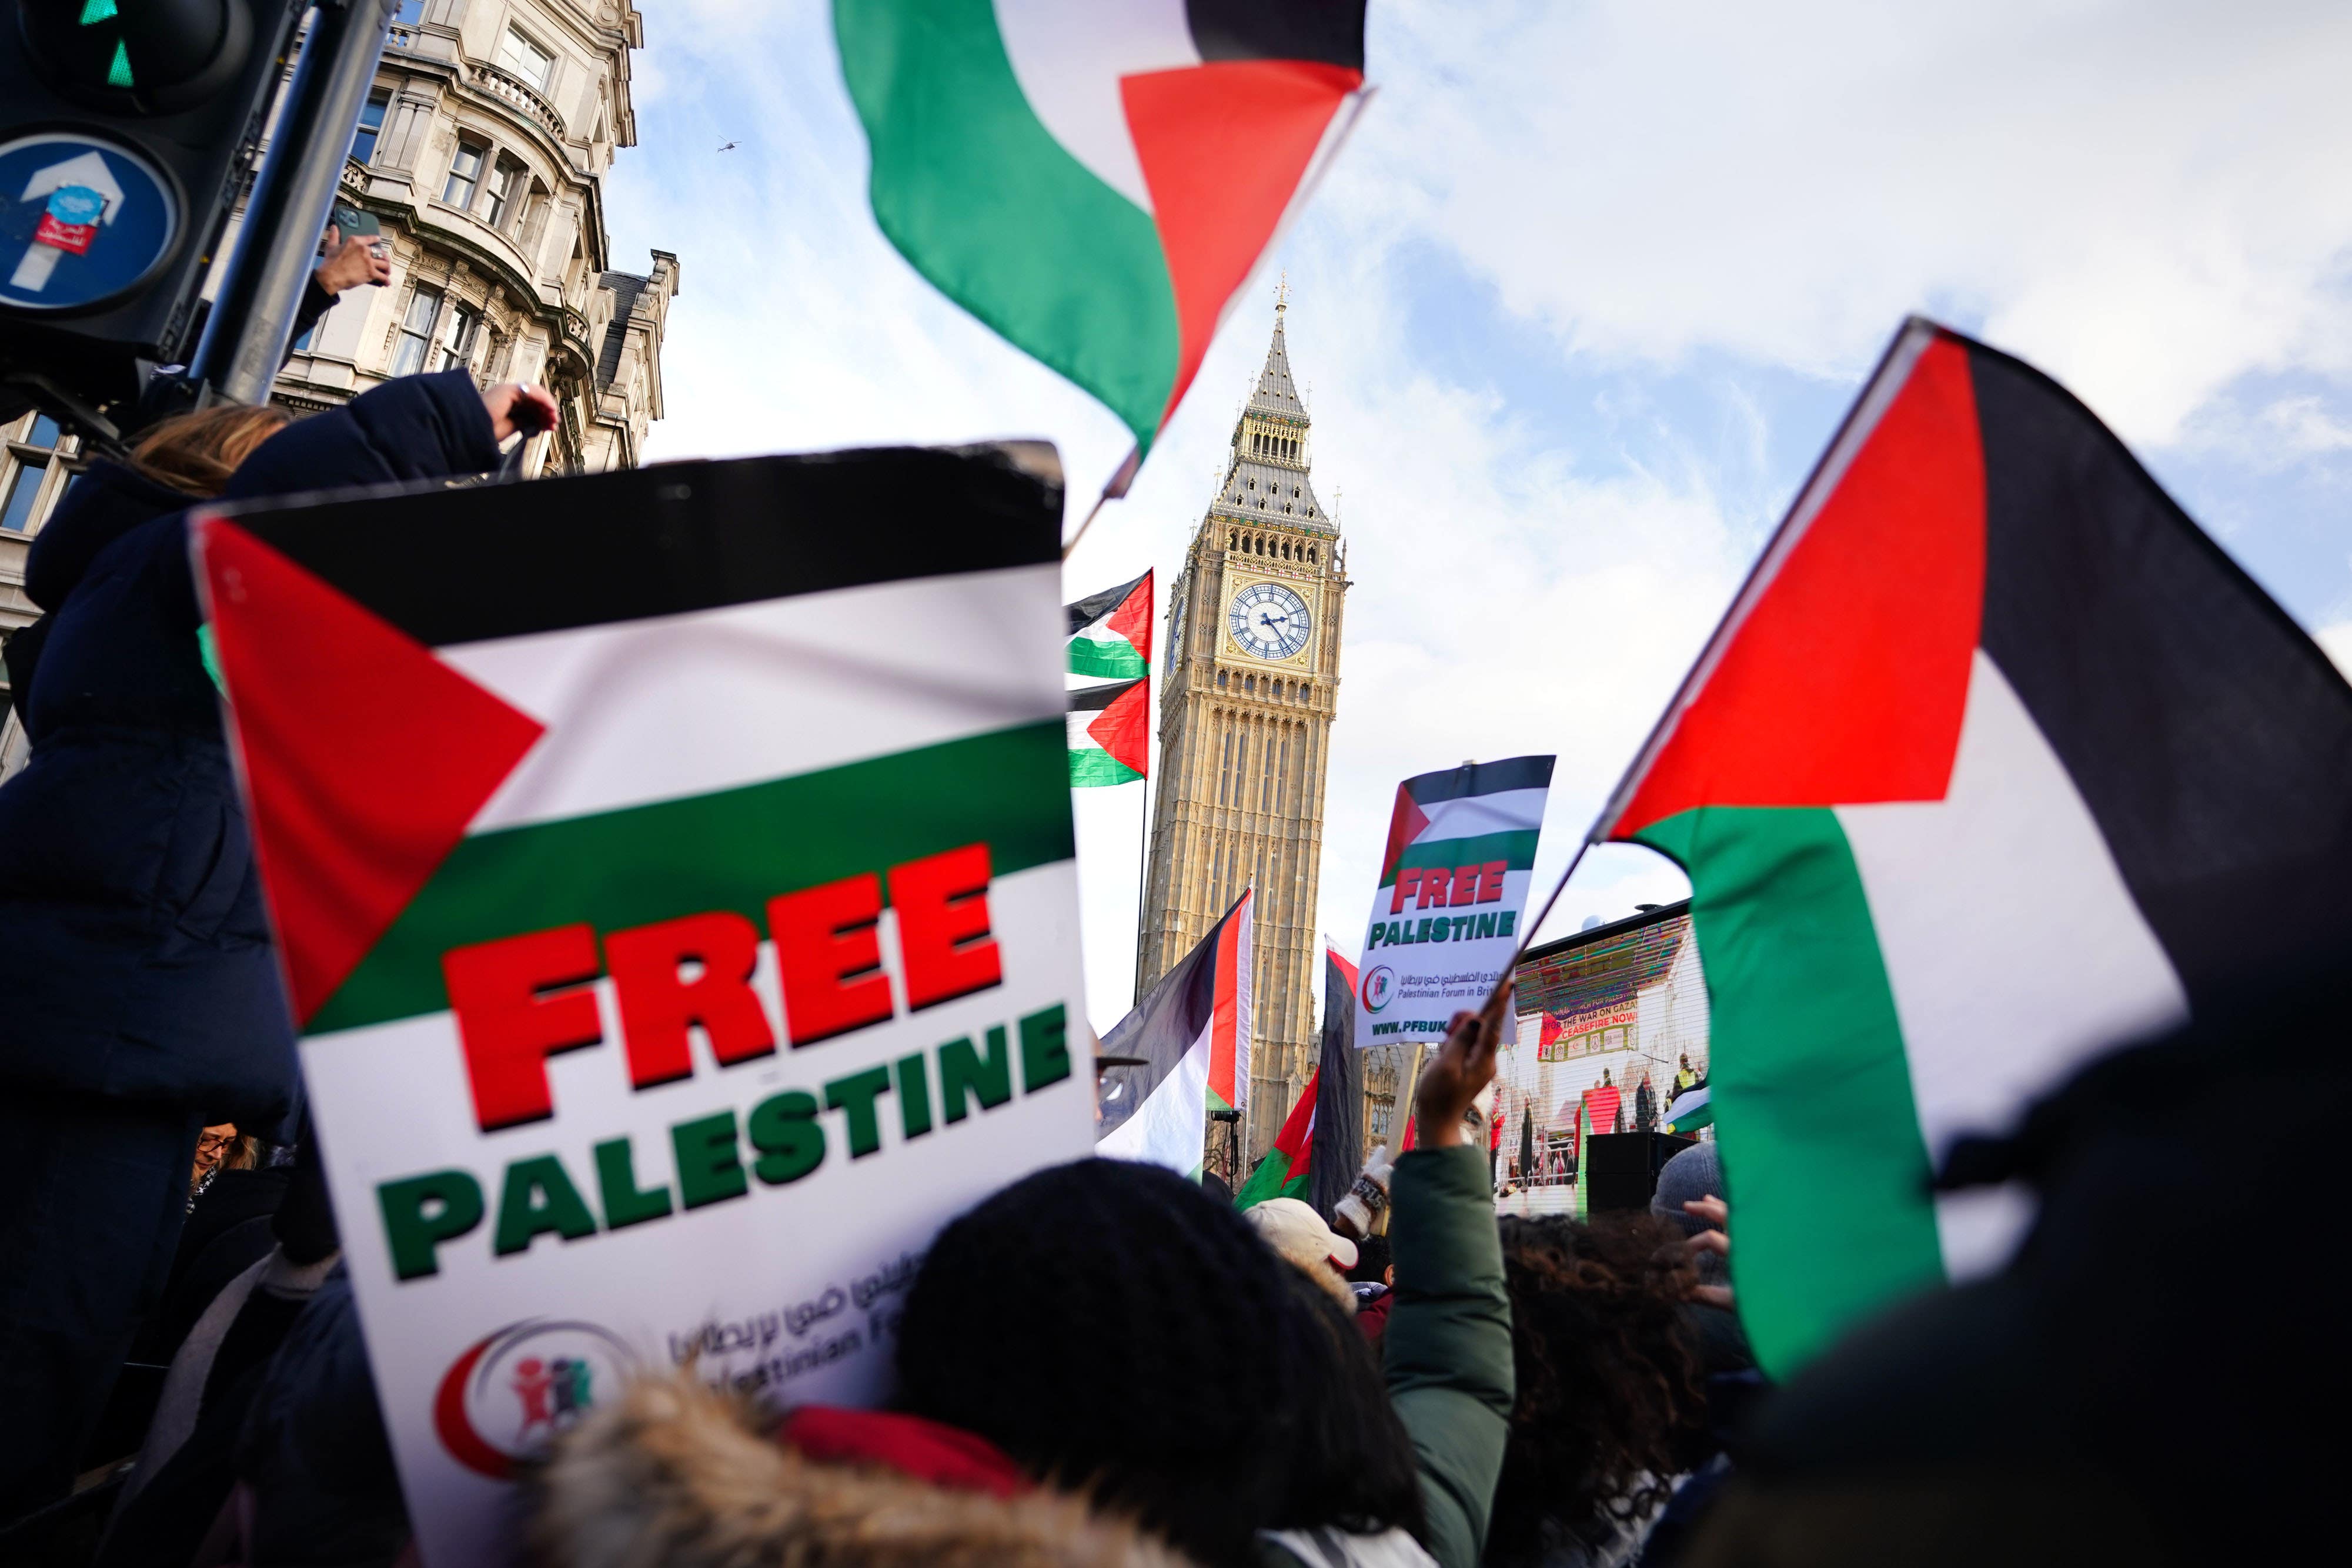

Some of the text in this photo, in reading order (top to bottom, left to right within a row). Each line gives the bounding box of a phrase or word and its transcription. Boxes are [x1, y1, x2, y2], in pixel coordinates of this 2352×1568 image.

[1389, 860, 1508, 915] FREE
[1368, 911, 1517, 951] PALESTINE
[442, 842, 1003, 1134] FREE
[1401, 974, 1423, 987] بريطانيا
[1424, 974, 1440, 987] في
[1398, 986, 1494, 999] Palestinian Forum in Brit
[1372, 1021, 1448, 1036] WWW.PFBUK
[1543, 1021, 1561, 1030] STOP
[1563, 1018, 1576, 1028] THE
[1579, 1011, 1597, 1022] WAR
[1599, 1007, 1611, 1017] ON
[1562, 1017, 1609, 1039] CEASEFIRE
[376, 1000, 1072, 1284] PALESTINE
